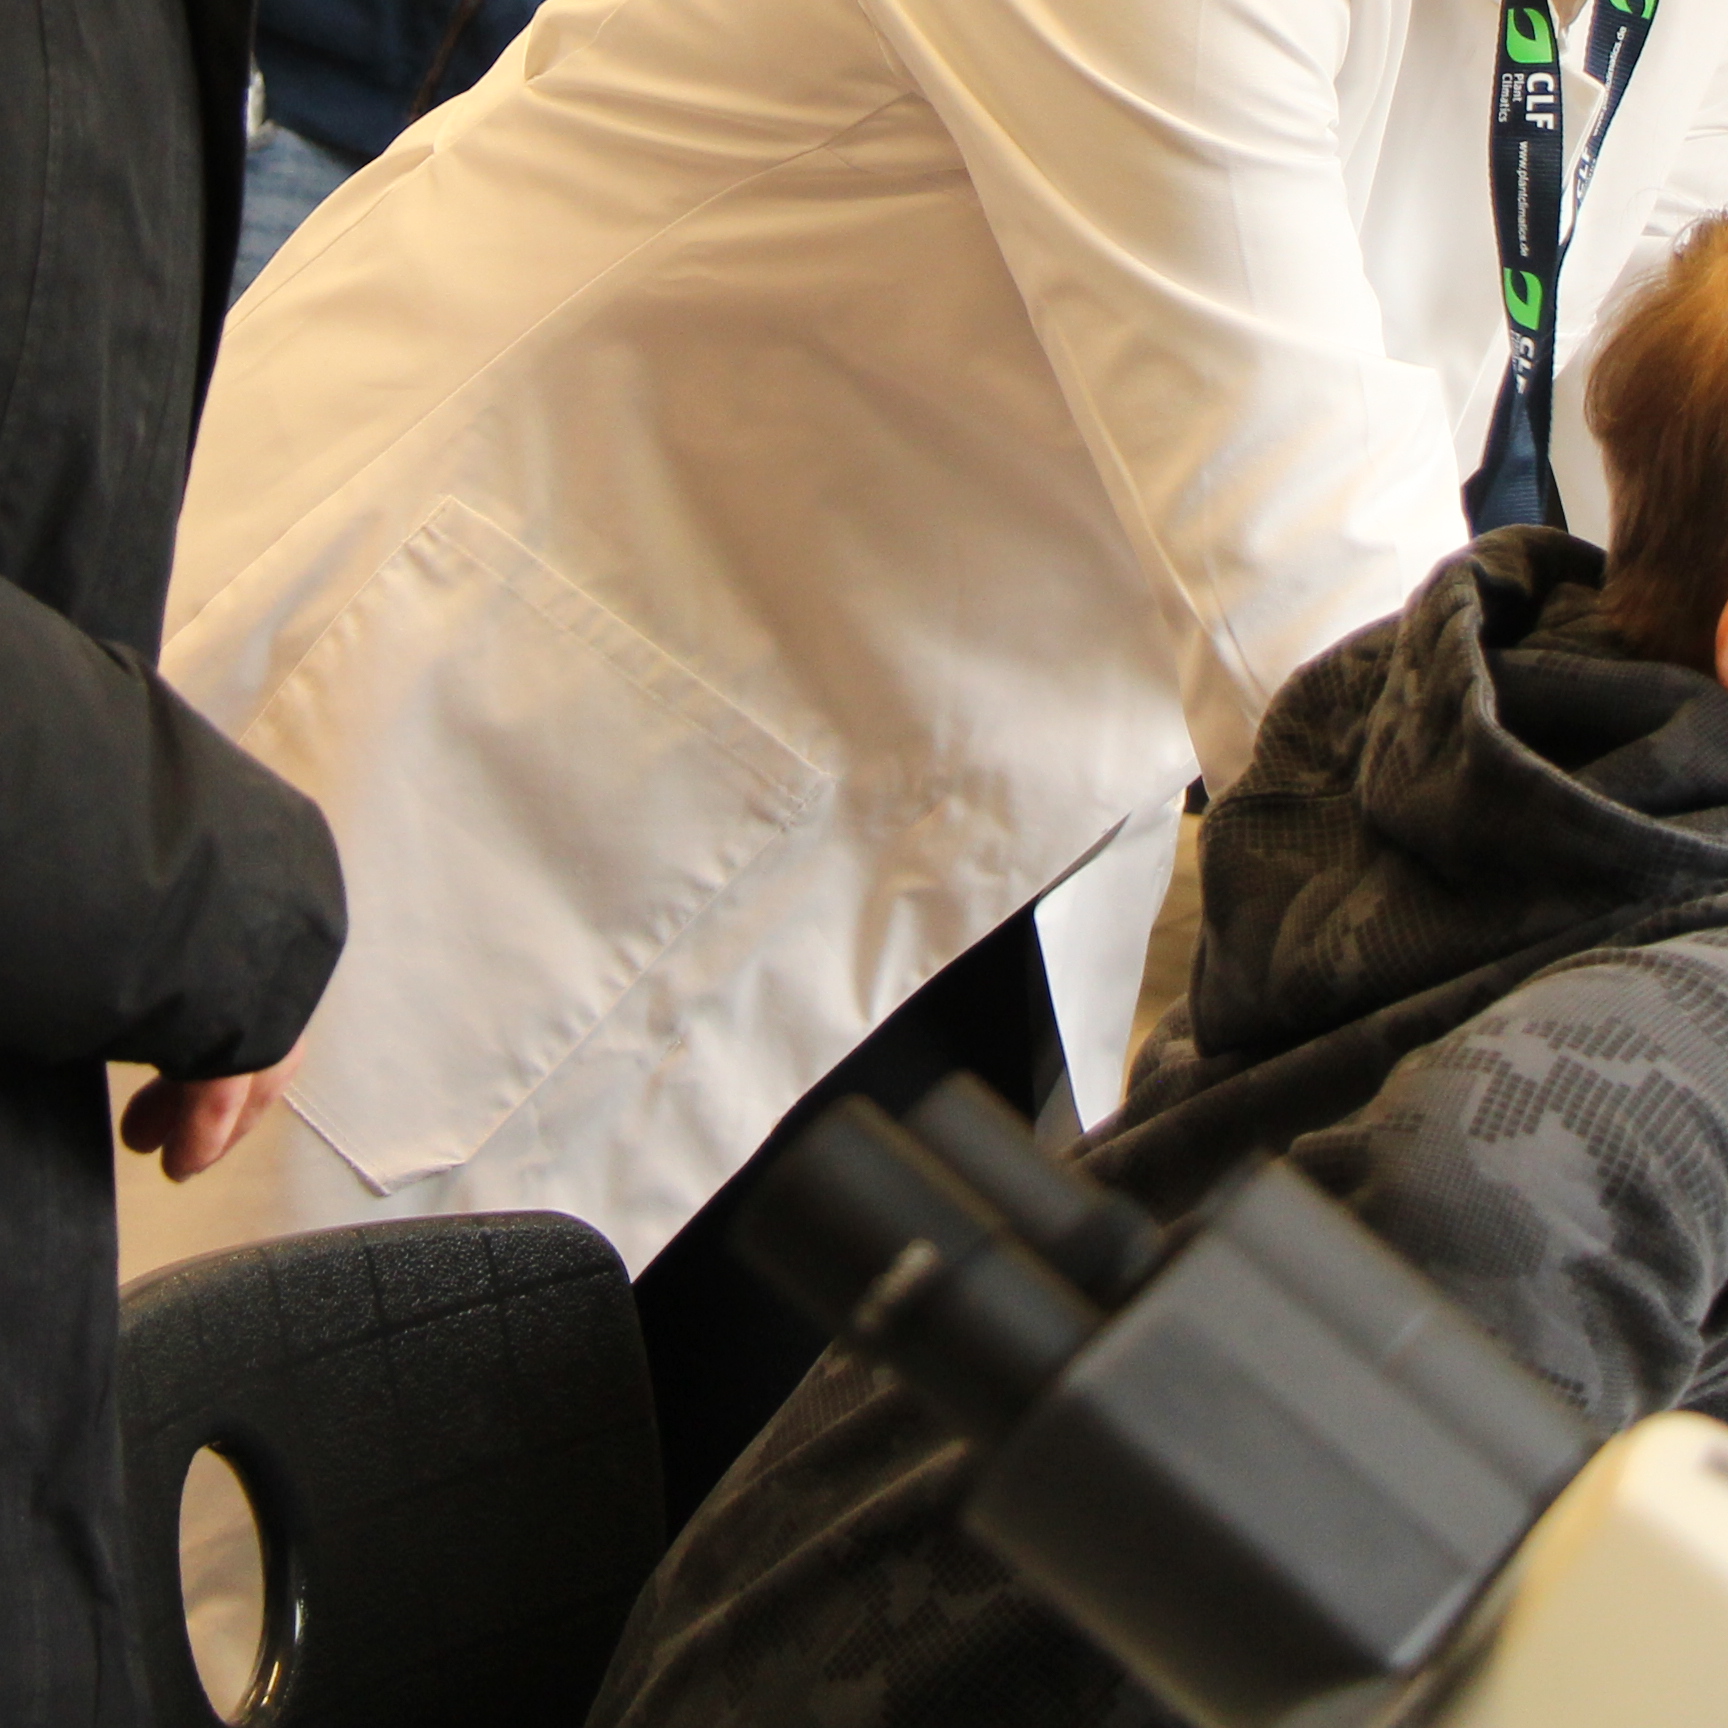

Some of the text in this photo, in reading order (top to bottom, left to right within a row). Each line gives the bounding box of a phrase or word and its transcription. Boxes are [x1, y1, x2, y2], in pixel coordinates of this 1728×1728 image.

[1497, 73, 1513, 123] Climatics
[1512, 73, 1525, 103] Plant
[1525, 72, 1556, 131] CLF
[1515, 140, 1530, 258] www.plantclimatics.de
